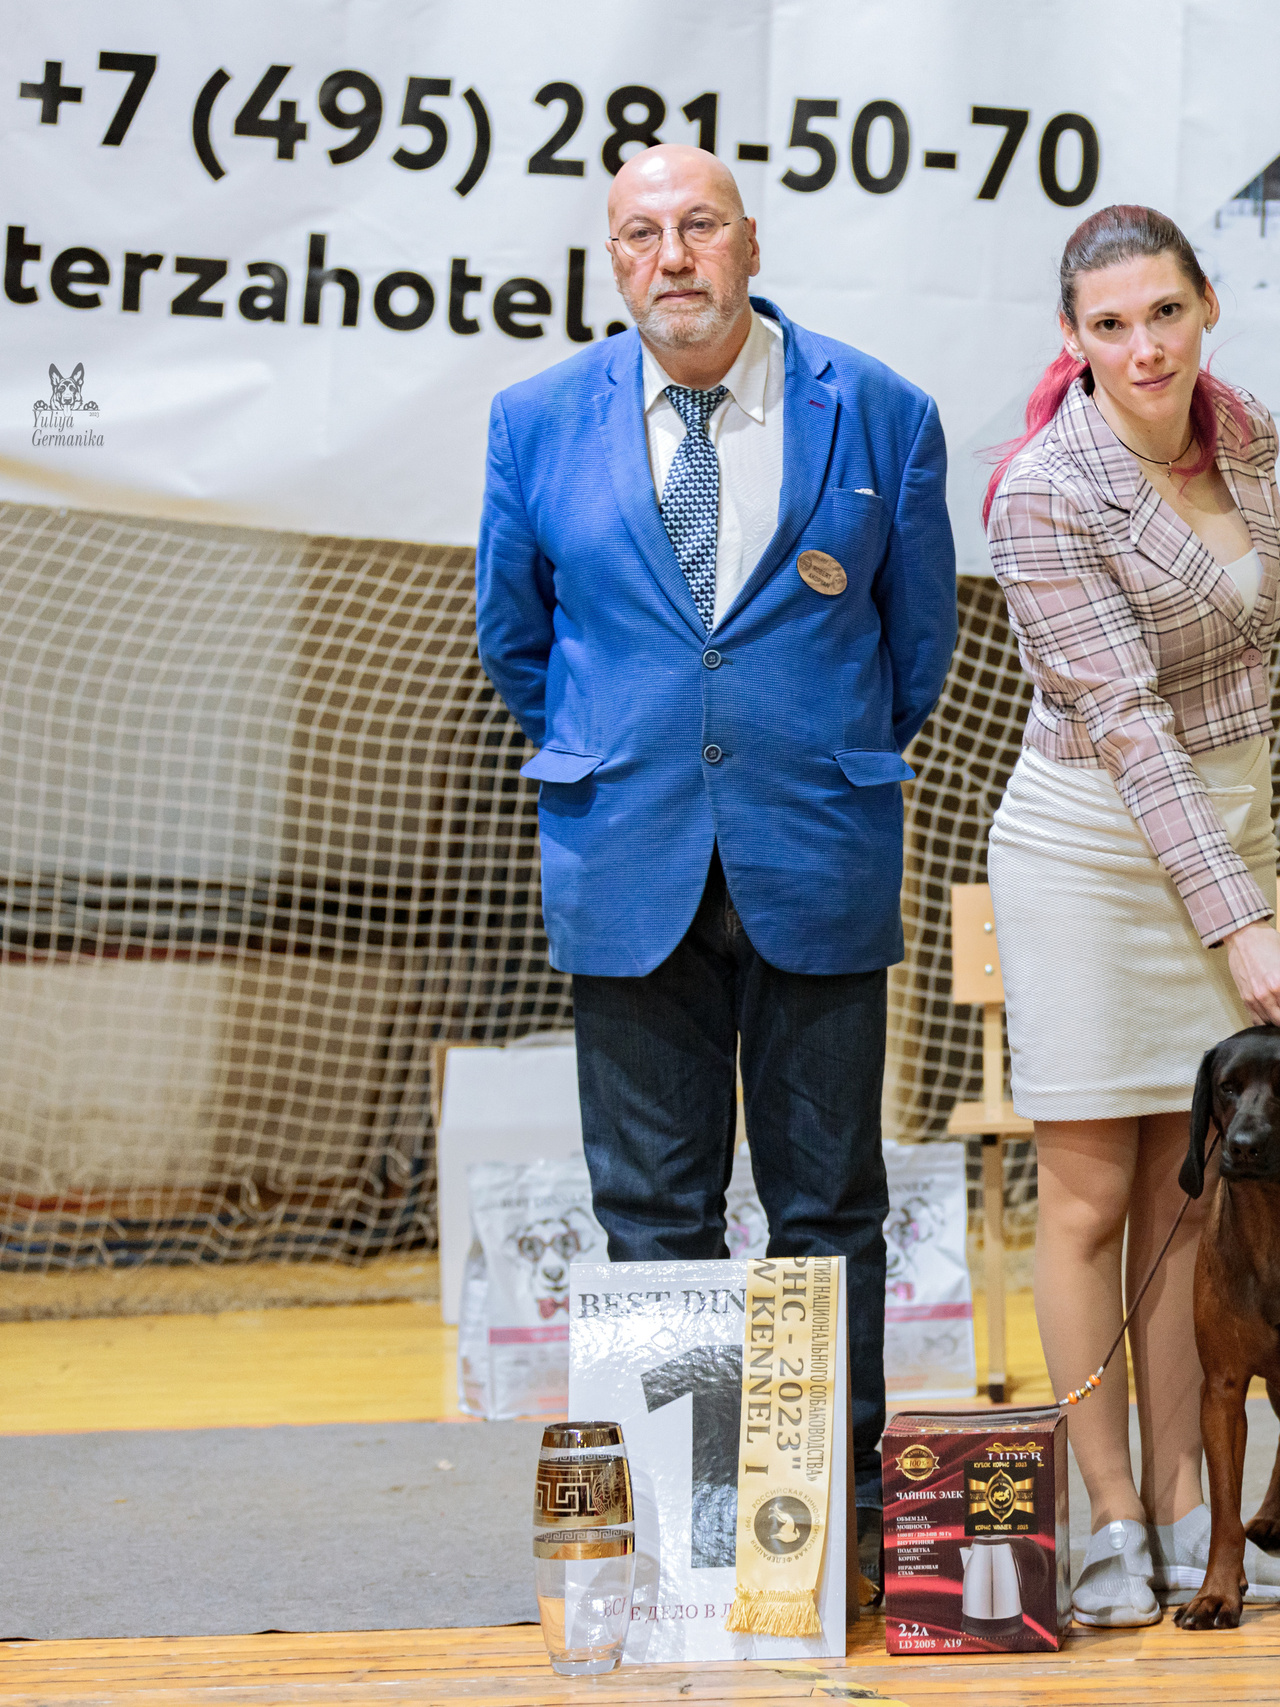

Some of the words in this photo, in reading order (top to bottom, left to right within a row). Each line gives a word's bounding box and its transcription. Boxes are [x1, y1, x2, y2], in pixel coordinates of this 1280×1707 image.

[20, 51, 158, 147] +7
[192, 66, 491, 198] (495)
[526, 82, 1100, 207] 281-50-70
[3, 225, 630, 343] terzahotel.
[578, 1291, 670, 1318] BEST
[810, 1286, 831, 1382] НАЦИОНАЛЬНОГО
[747, 1295, 776, 1444] KENNEL
[640, 1344, 743, 1569] 1
[745, 1463, 769, 1475] I
[896, 1491, 936, 1500] ЧАЙНИК
[939, 1490, 964, 1499] ЭЛЕК
[645, 1604, 698, 1624] ДЕЛО
[704, 1603, 716, 1619] В
[899, 1641, 912, 1650] LD
[914, 1640, 936, 1649] 2005
